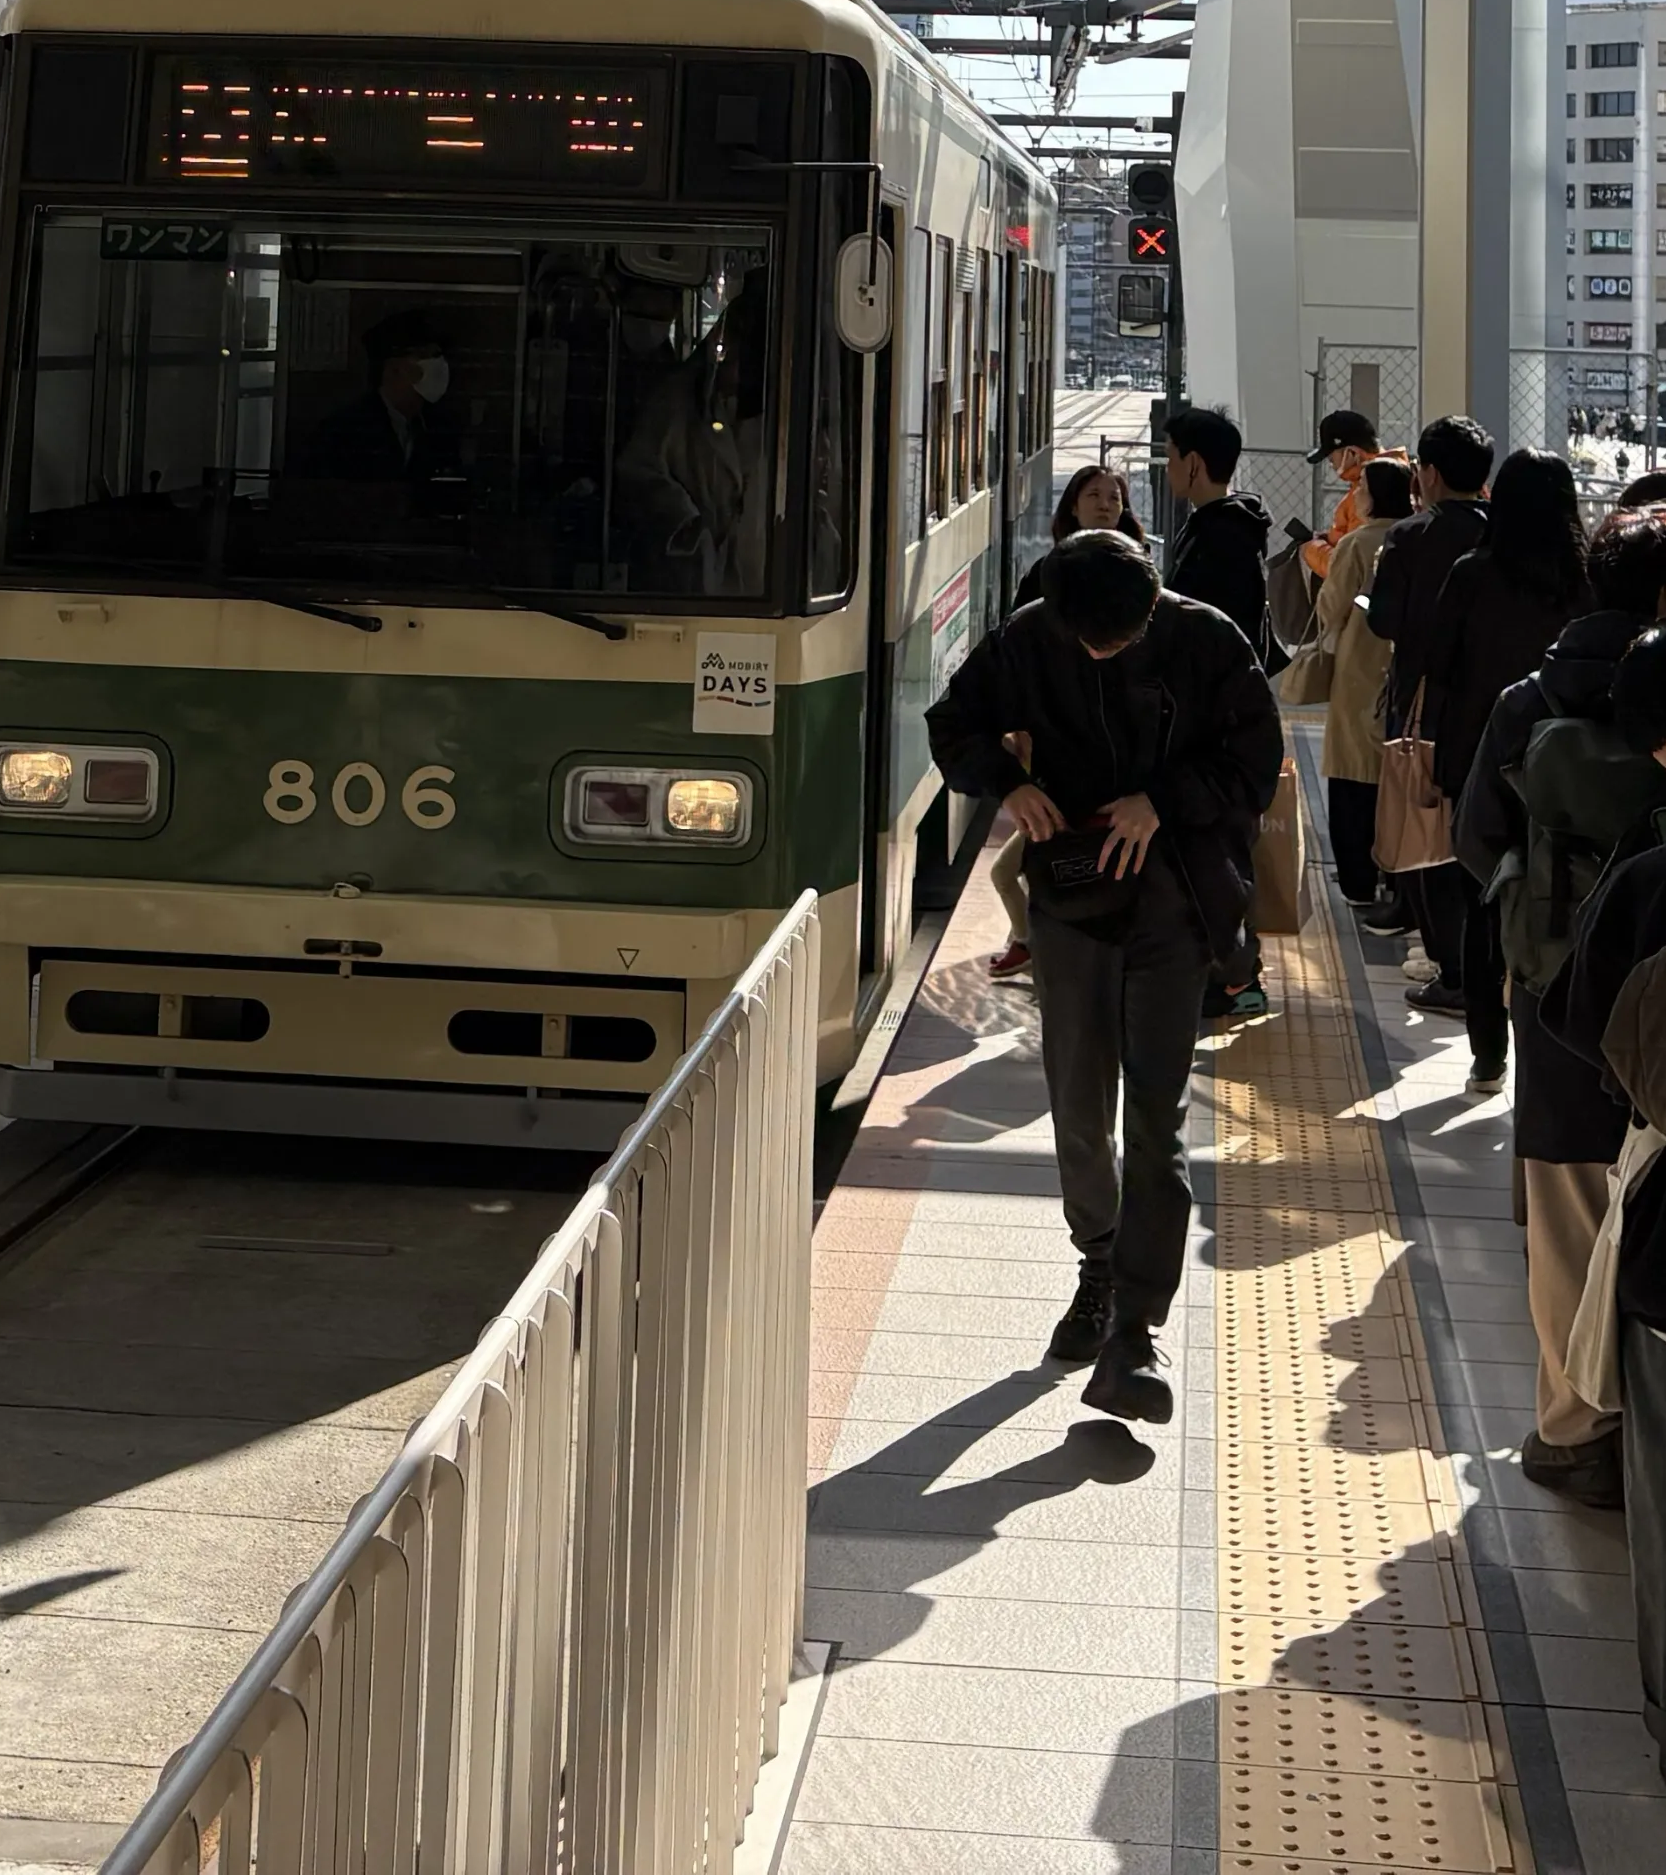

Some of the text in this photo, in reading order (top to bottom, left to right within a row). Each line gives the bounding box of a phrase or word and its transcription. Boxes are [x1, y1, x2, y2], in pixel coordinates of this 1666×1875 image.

[106, 223, 224, 254] ワンマン
[703, 675, 767, 694] DAYS
[262, 759, 457, 831] 806
